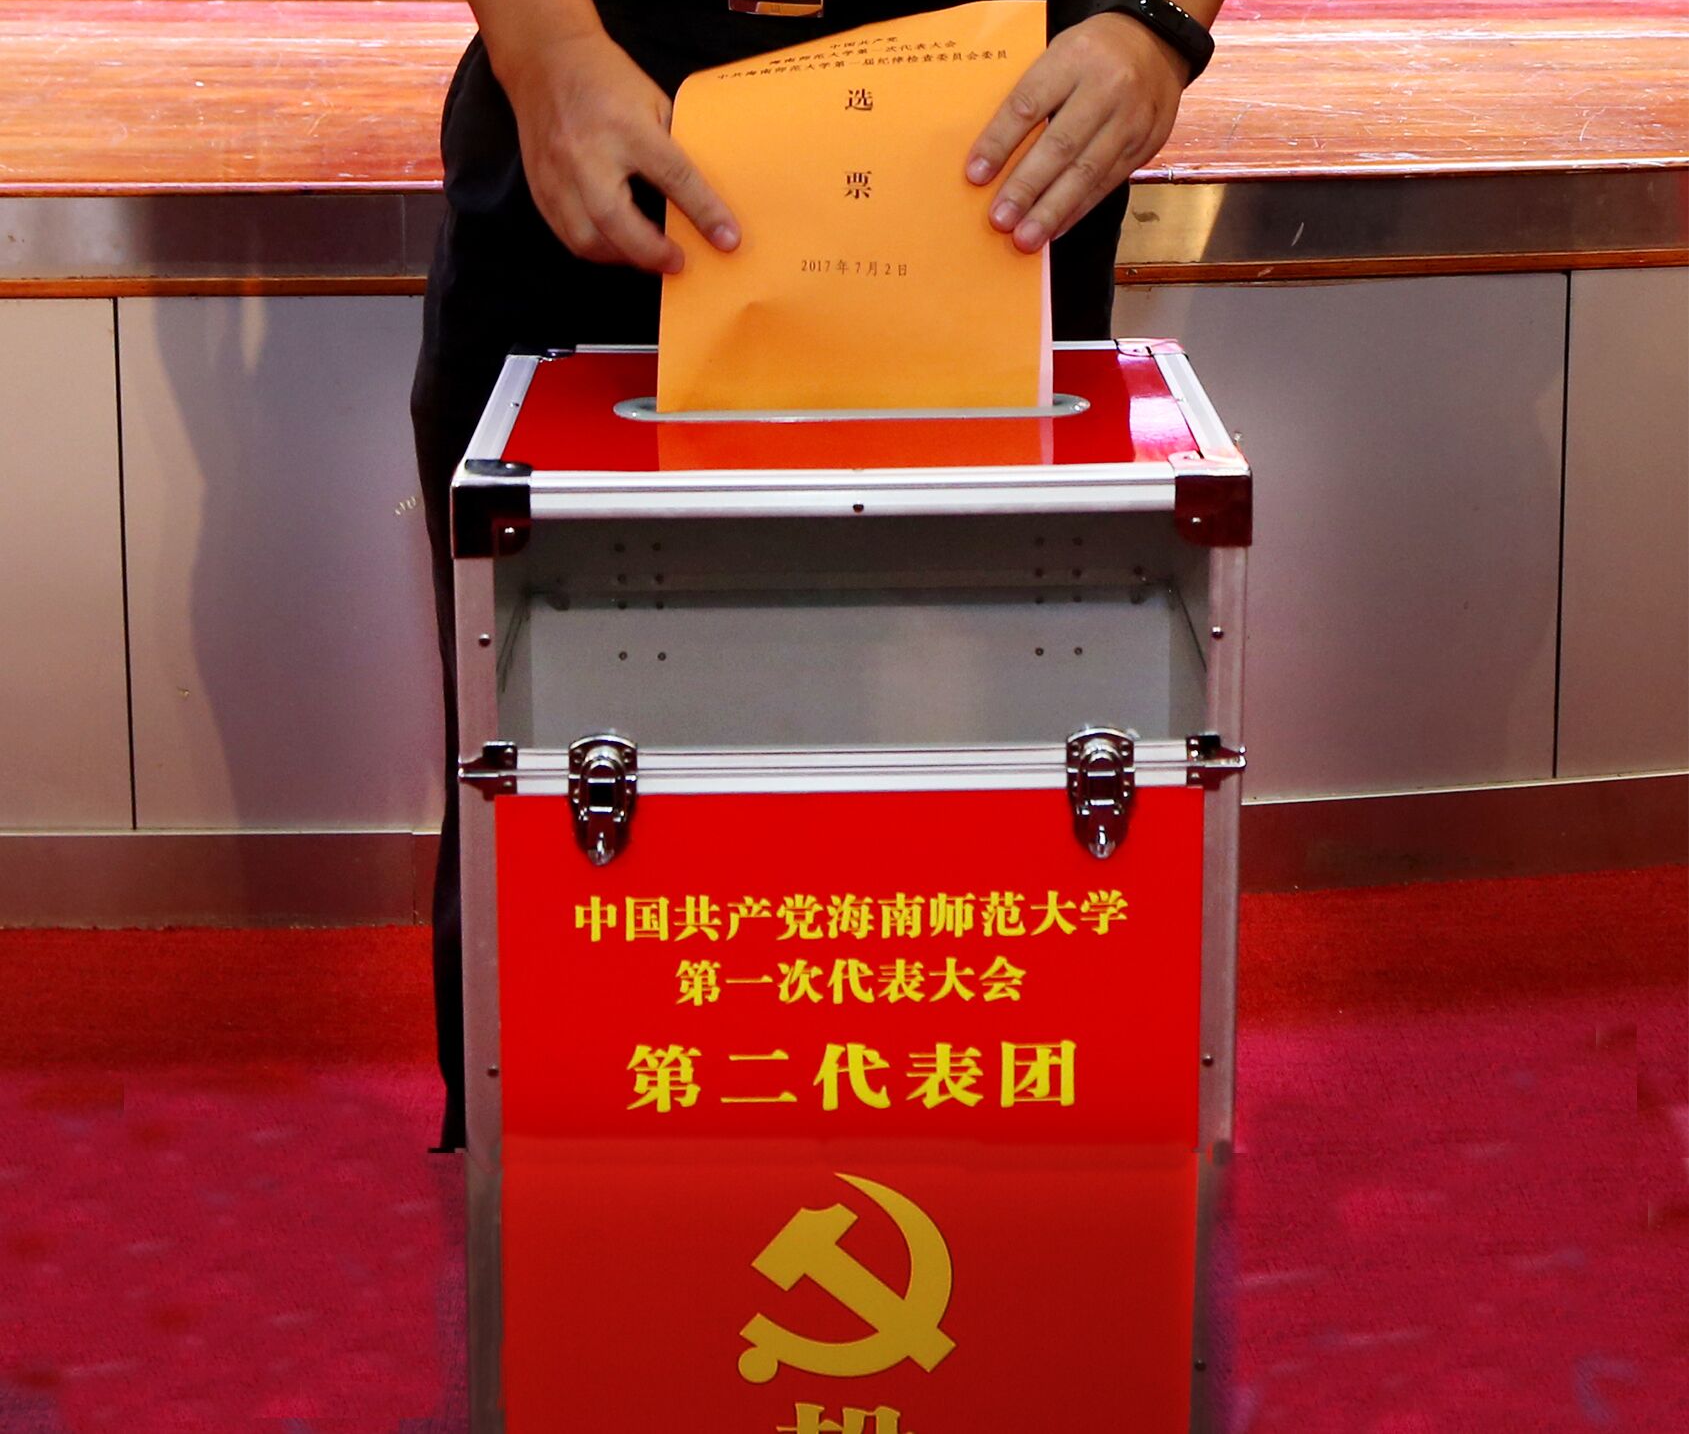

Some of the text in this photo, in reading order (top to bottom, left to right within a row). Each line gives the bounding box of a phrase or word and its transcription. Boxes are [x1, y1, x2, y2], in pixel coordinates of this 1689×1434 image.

[845, 88, 873, 112] 选
[845, 170, 872, 200] 票
[574, 889, 1128, 942] 中国共产党海南师范大学
[675, 955, 1026, 1006] 第一次代表大会
[626, 1039, 1077, 1113] 第二代表团
